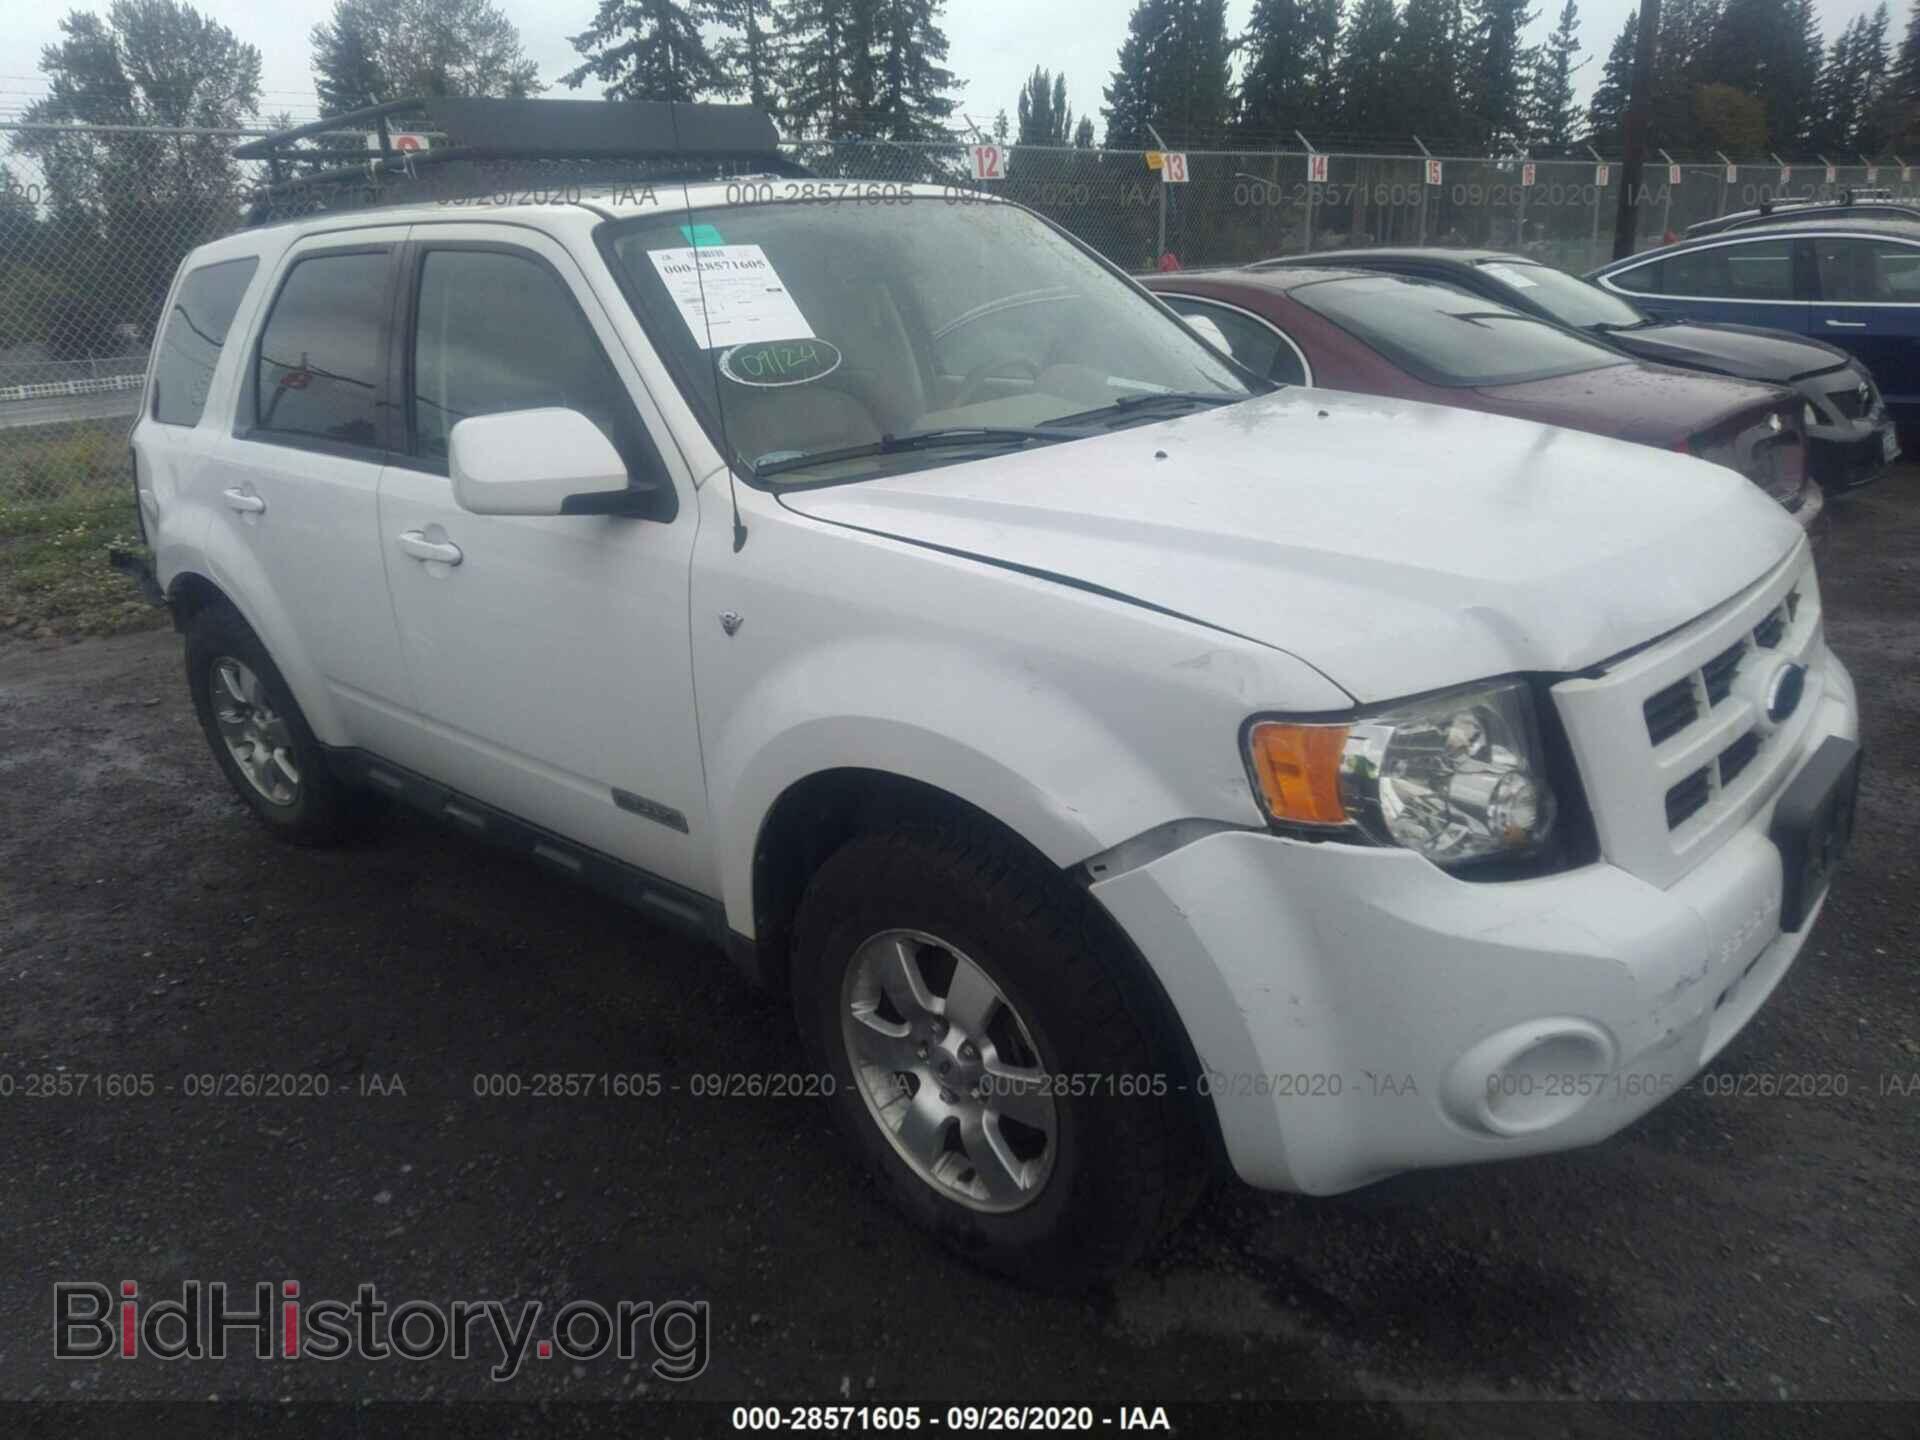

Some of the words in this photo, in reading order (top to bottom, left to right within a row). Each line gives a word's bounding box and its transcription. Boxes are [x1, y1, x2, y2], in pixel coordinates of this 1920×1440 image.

[976, 147, 999, 178] 12
[1164, 153, 1185, 181] 13
[1311, 156, 1325, 180] 14
[1429, 160, 1440, 183] 15
[663, 259, 766, 275] 000-28571605
[741, 344, 820, 377] 09/24
